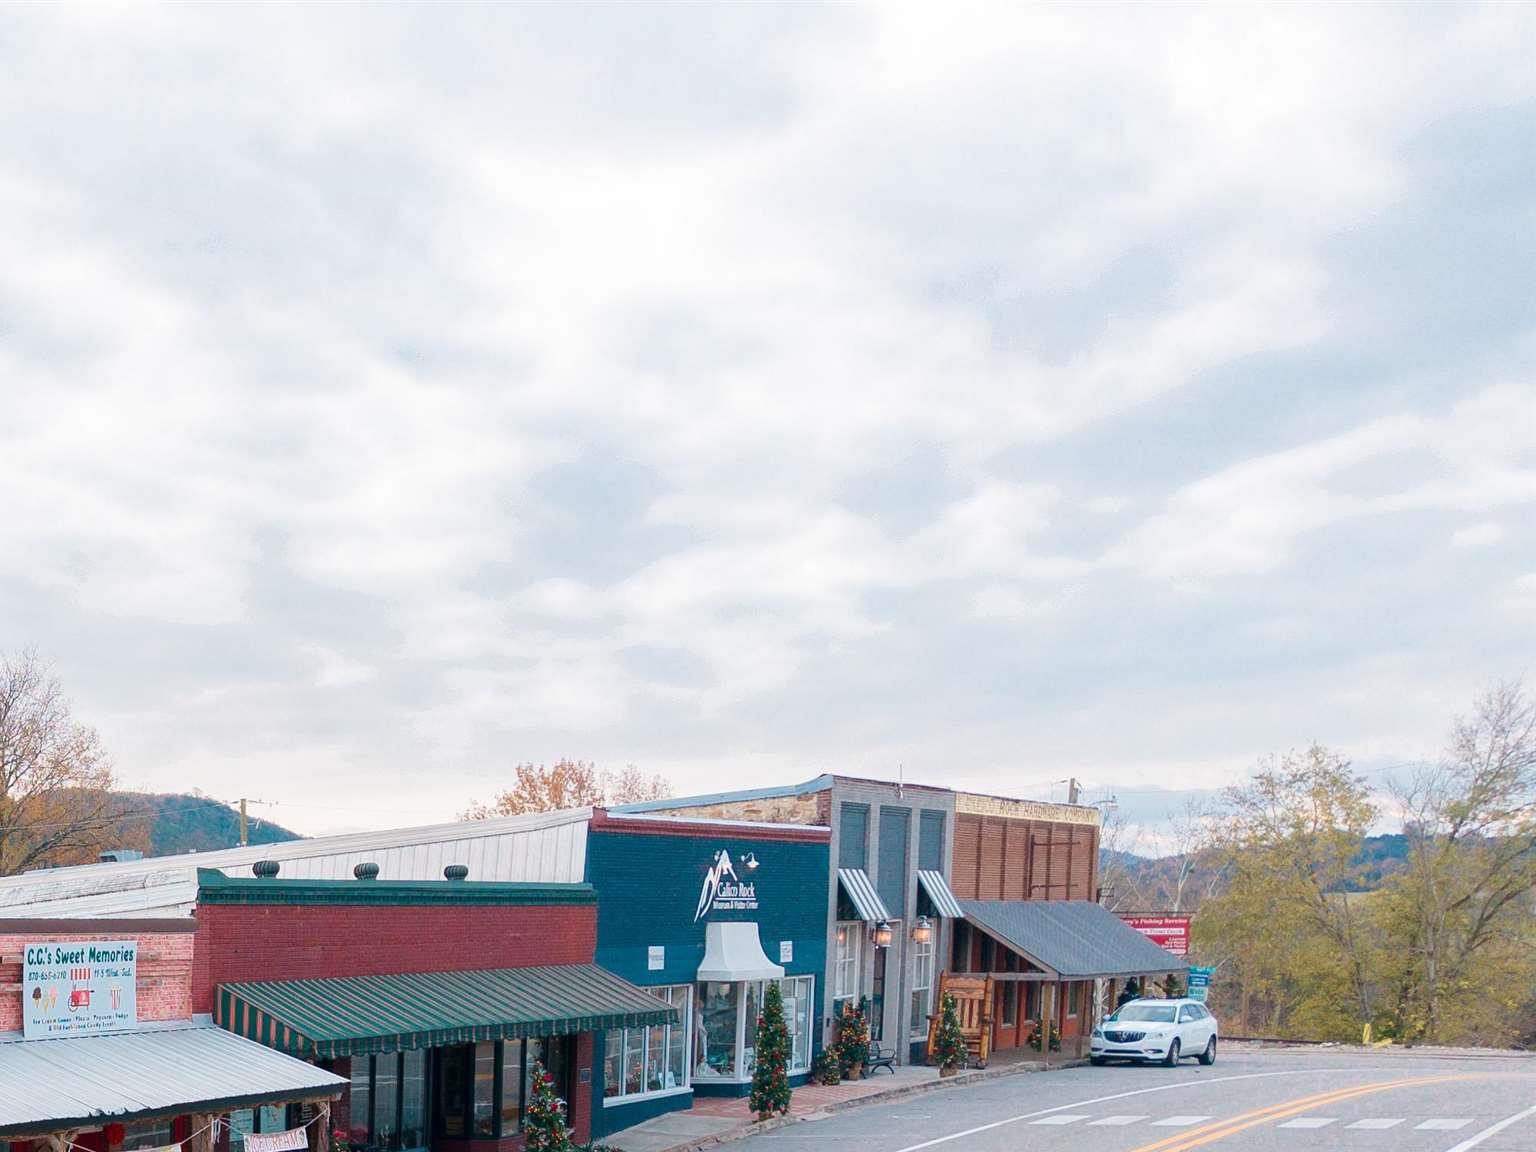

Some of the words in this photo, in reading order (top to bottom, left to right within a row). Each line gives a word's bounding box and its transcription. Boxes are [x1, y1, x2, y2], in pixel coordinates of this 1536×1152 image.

[717, 881, 738, 897] Calico
[739, 882, 755, 897] Rock
[55, 947, 85, 965] Sweet
[88, 945, 134, 963] Memories
